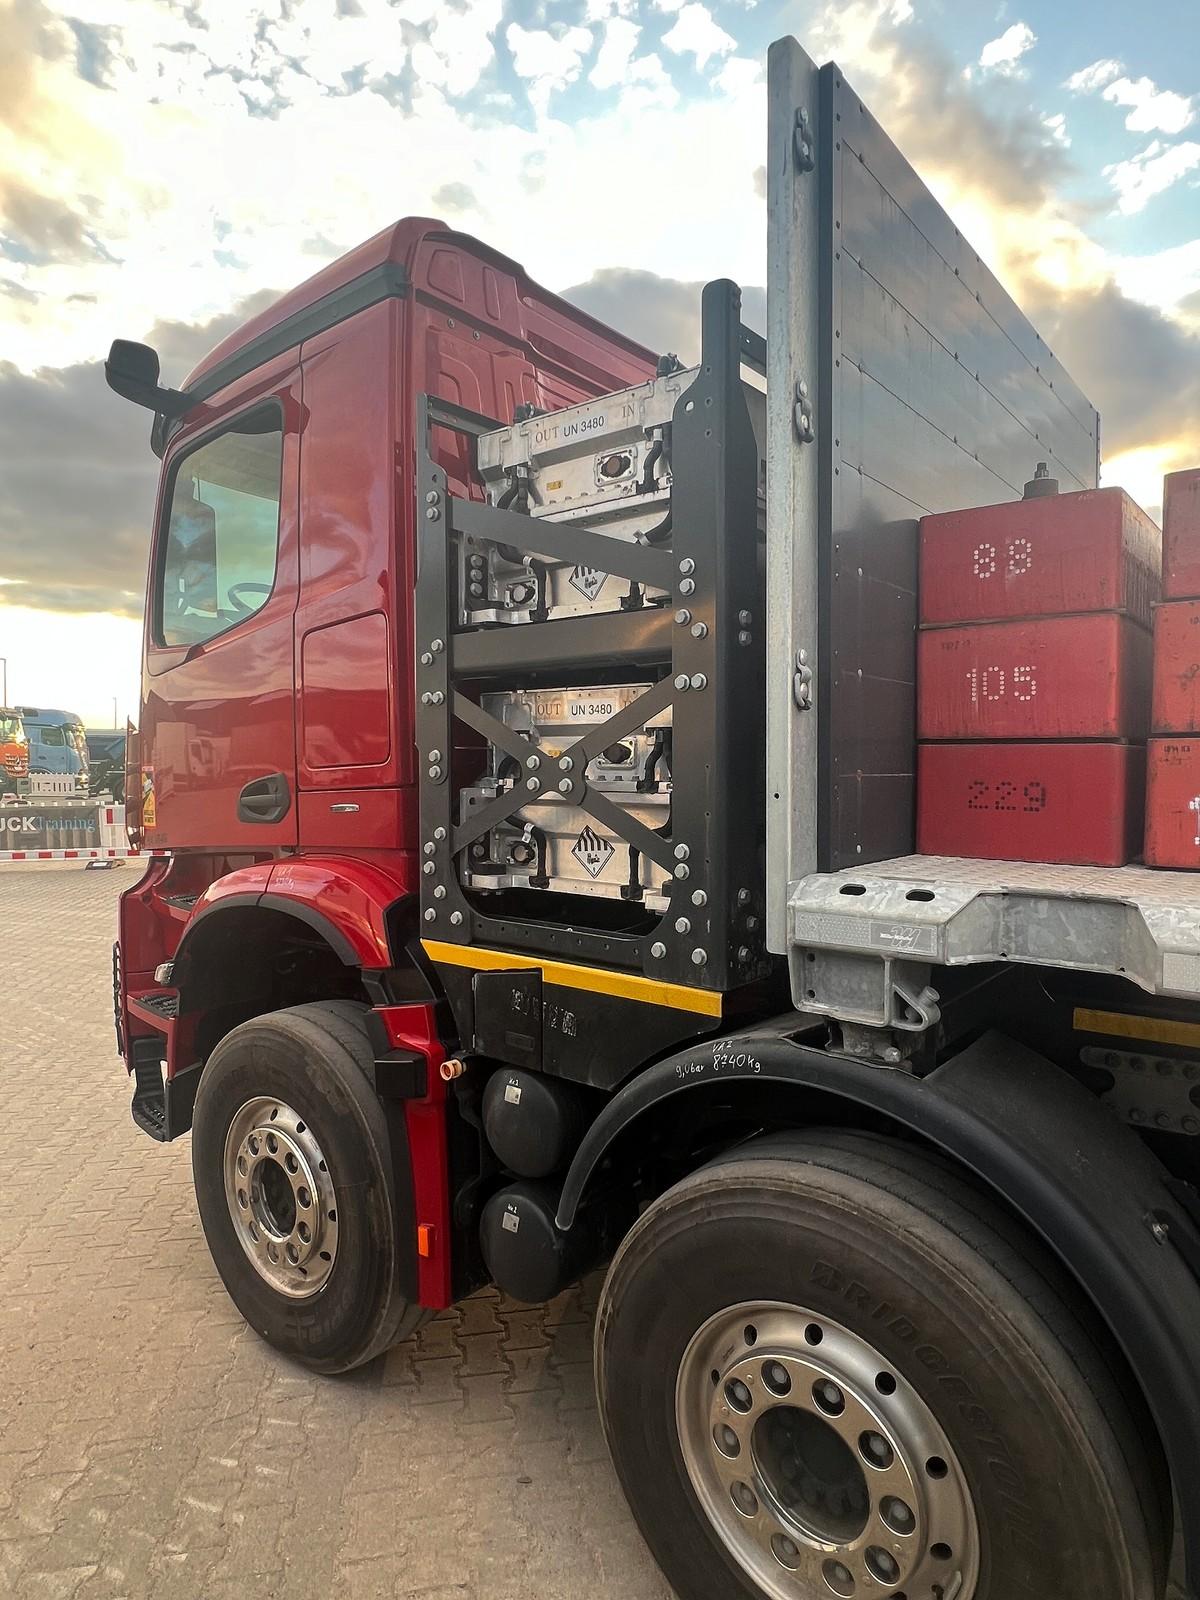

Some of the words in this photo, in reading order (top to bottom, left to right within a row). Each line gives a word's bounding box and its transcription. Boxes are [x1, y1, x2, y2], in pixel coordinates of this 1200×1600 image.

[536, 427, 559, 443] OUT
[563, 422, 578, 437] UN
[581, 415, 605, 433] 3480
[622, 404, 635, 418] IN
[973, 538, 1032, 579] 88
[966, 666, 1037, 702] 105
[537, 703, 561, 716] OUT
[571, 704, 586, 716] UN
[588, 703, 612, 716] 3480
[968, 781, 1045, 813] 229
[36, 816, 96, 833] Training
